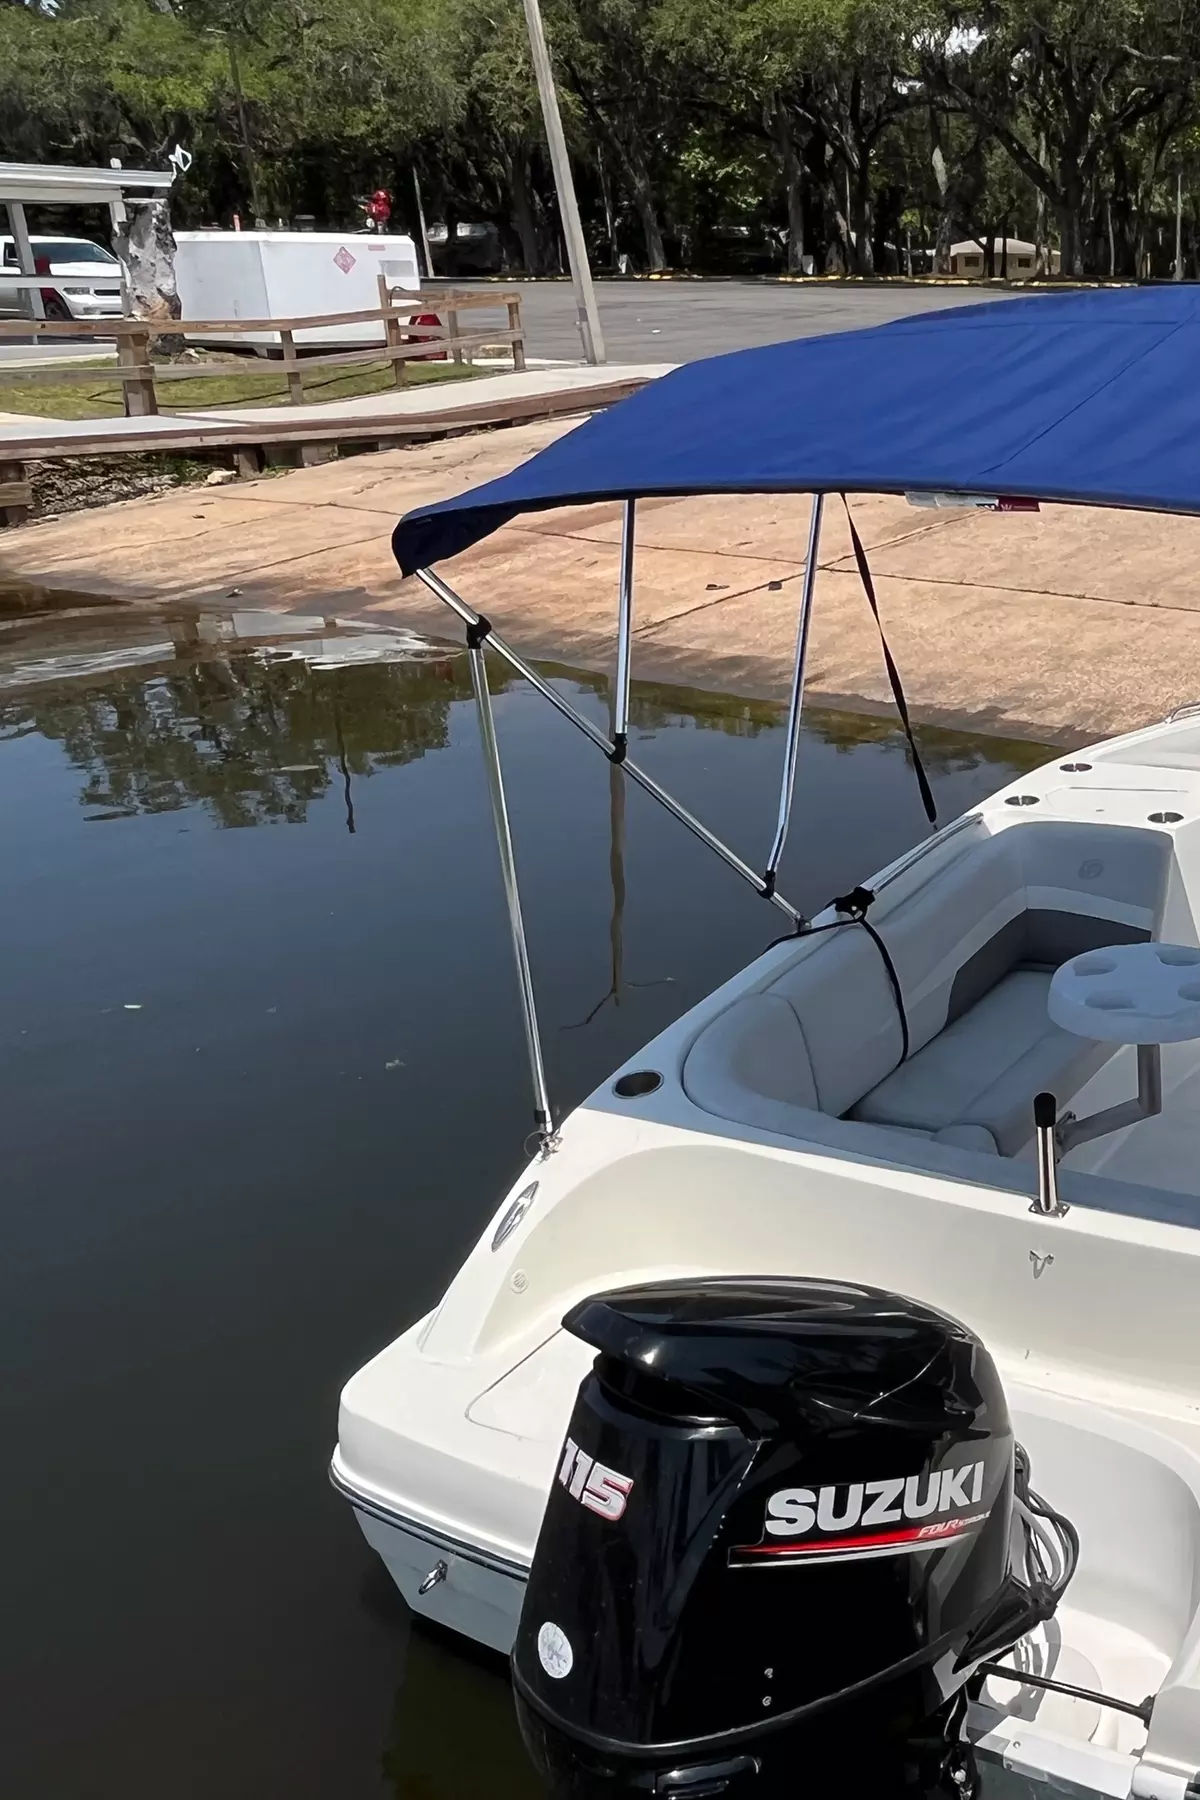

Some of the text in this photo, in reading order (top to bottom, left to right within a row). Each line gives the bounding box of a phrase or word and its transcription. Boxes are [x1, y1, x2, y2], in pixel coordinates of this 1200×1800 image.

[559, 1437, 634, 1521] 115
[765, 1461, 985, 1536] SUZUKI
[917, 1519, 960, 1537] FOUR
